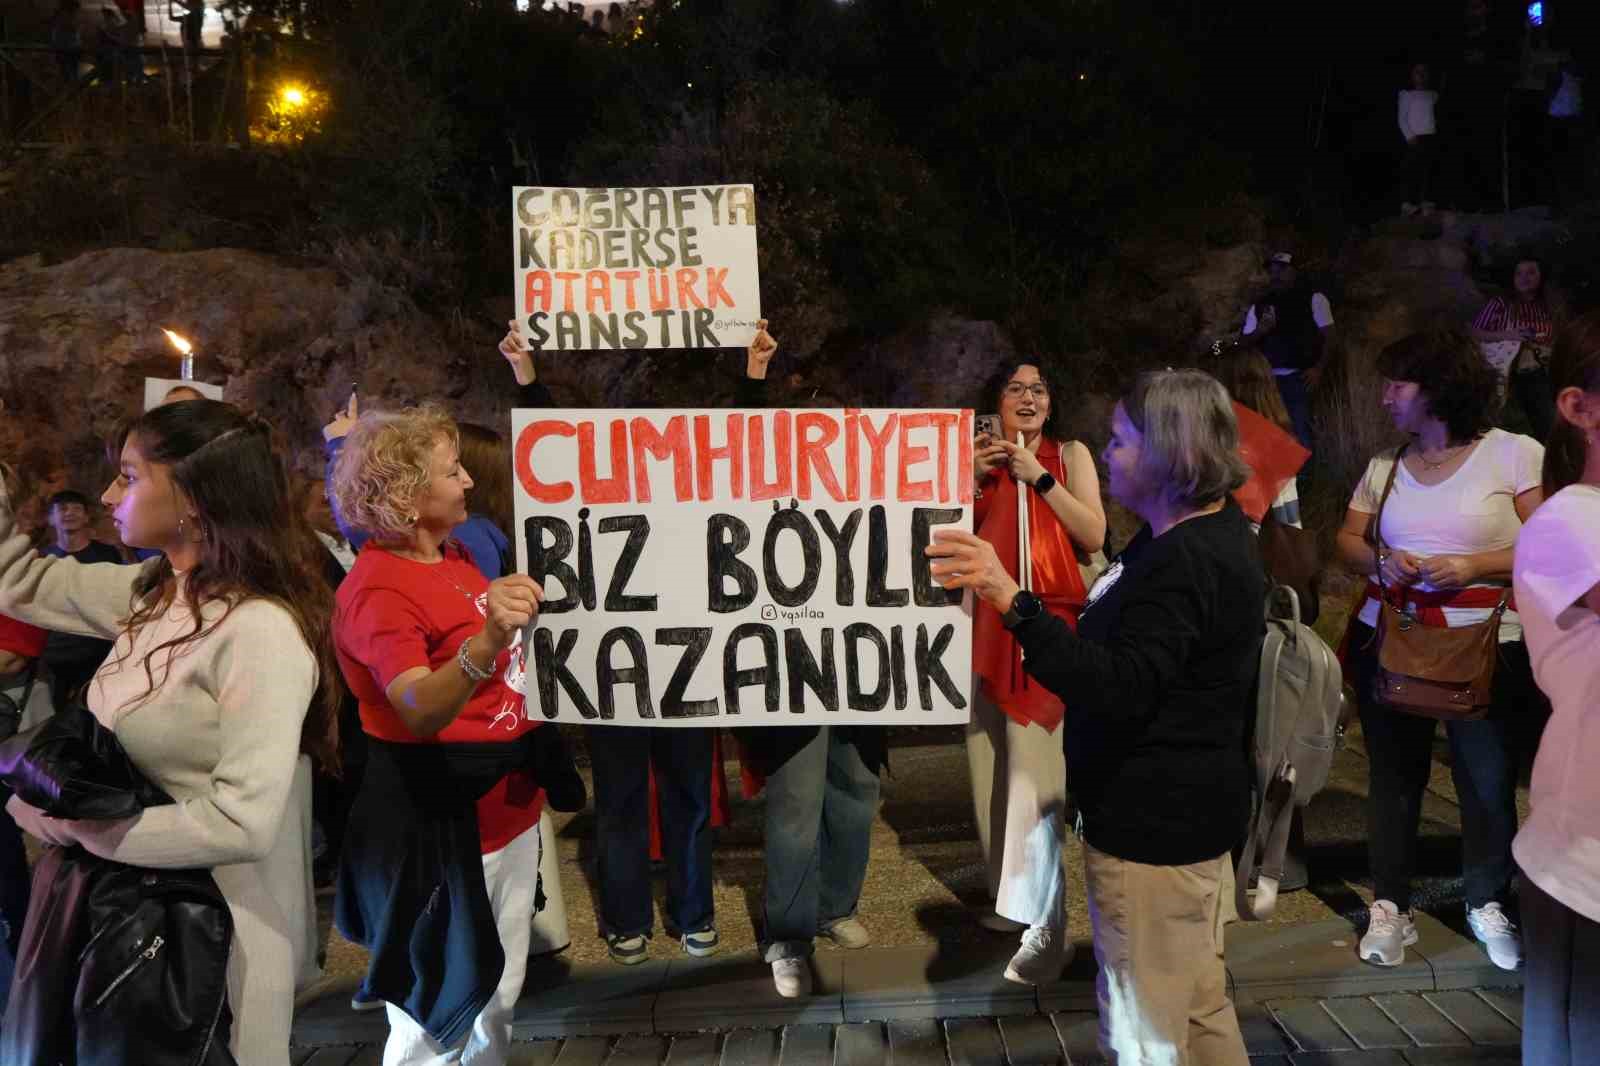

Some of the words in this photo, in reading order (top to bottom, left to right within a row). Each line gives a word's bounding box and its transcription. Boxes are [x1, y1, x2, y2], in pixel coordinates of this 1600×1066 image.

[517, 187, 756, 229] COĞRAFYA
[519, 227, 703, 269] KADERSE
[524, 266, 736, 313] ATATÜRK
[527, 308, 721, 350] ŞANSTIR
[515, 408, 973, 504] CUMHURİYETİ
[525, 507, 657, 614] BİZ
[707, 497, 964, 613] BÖYLE
[533, 622, 967, 719] KAZANDIK
